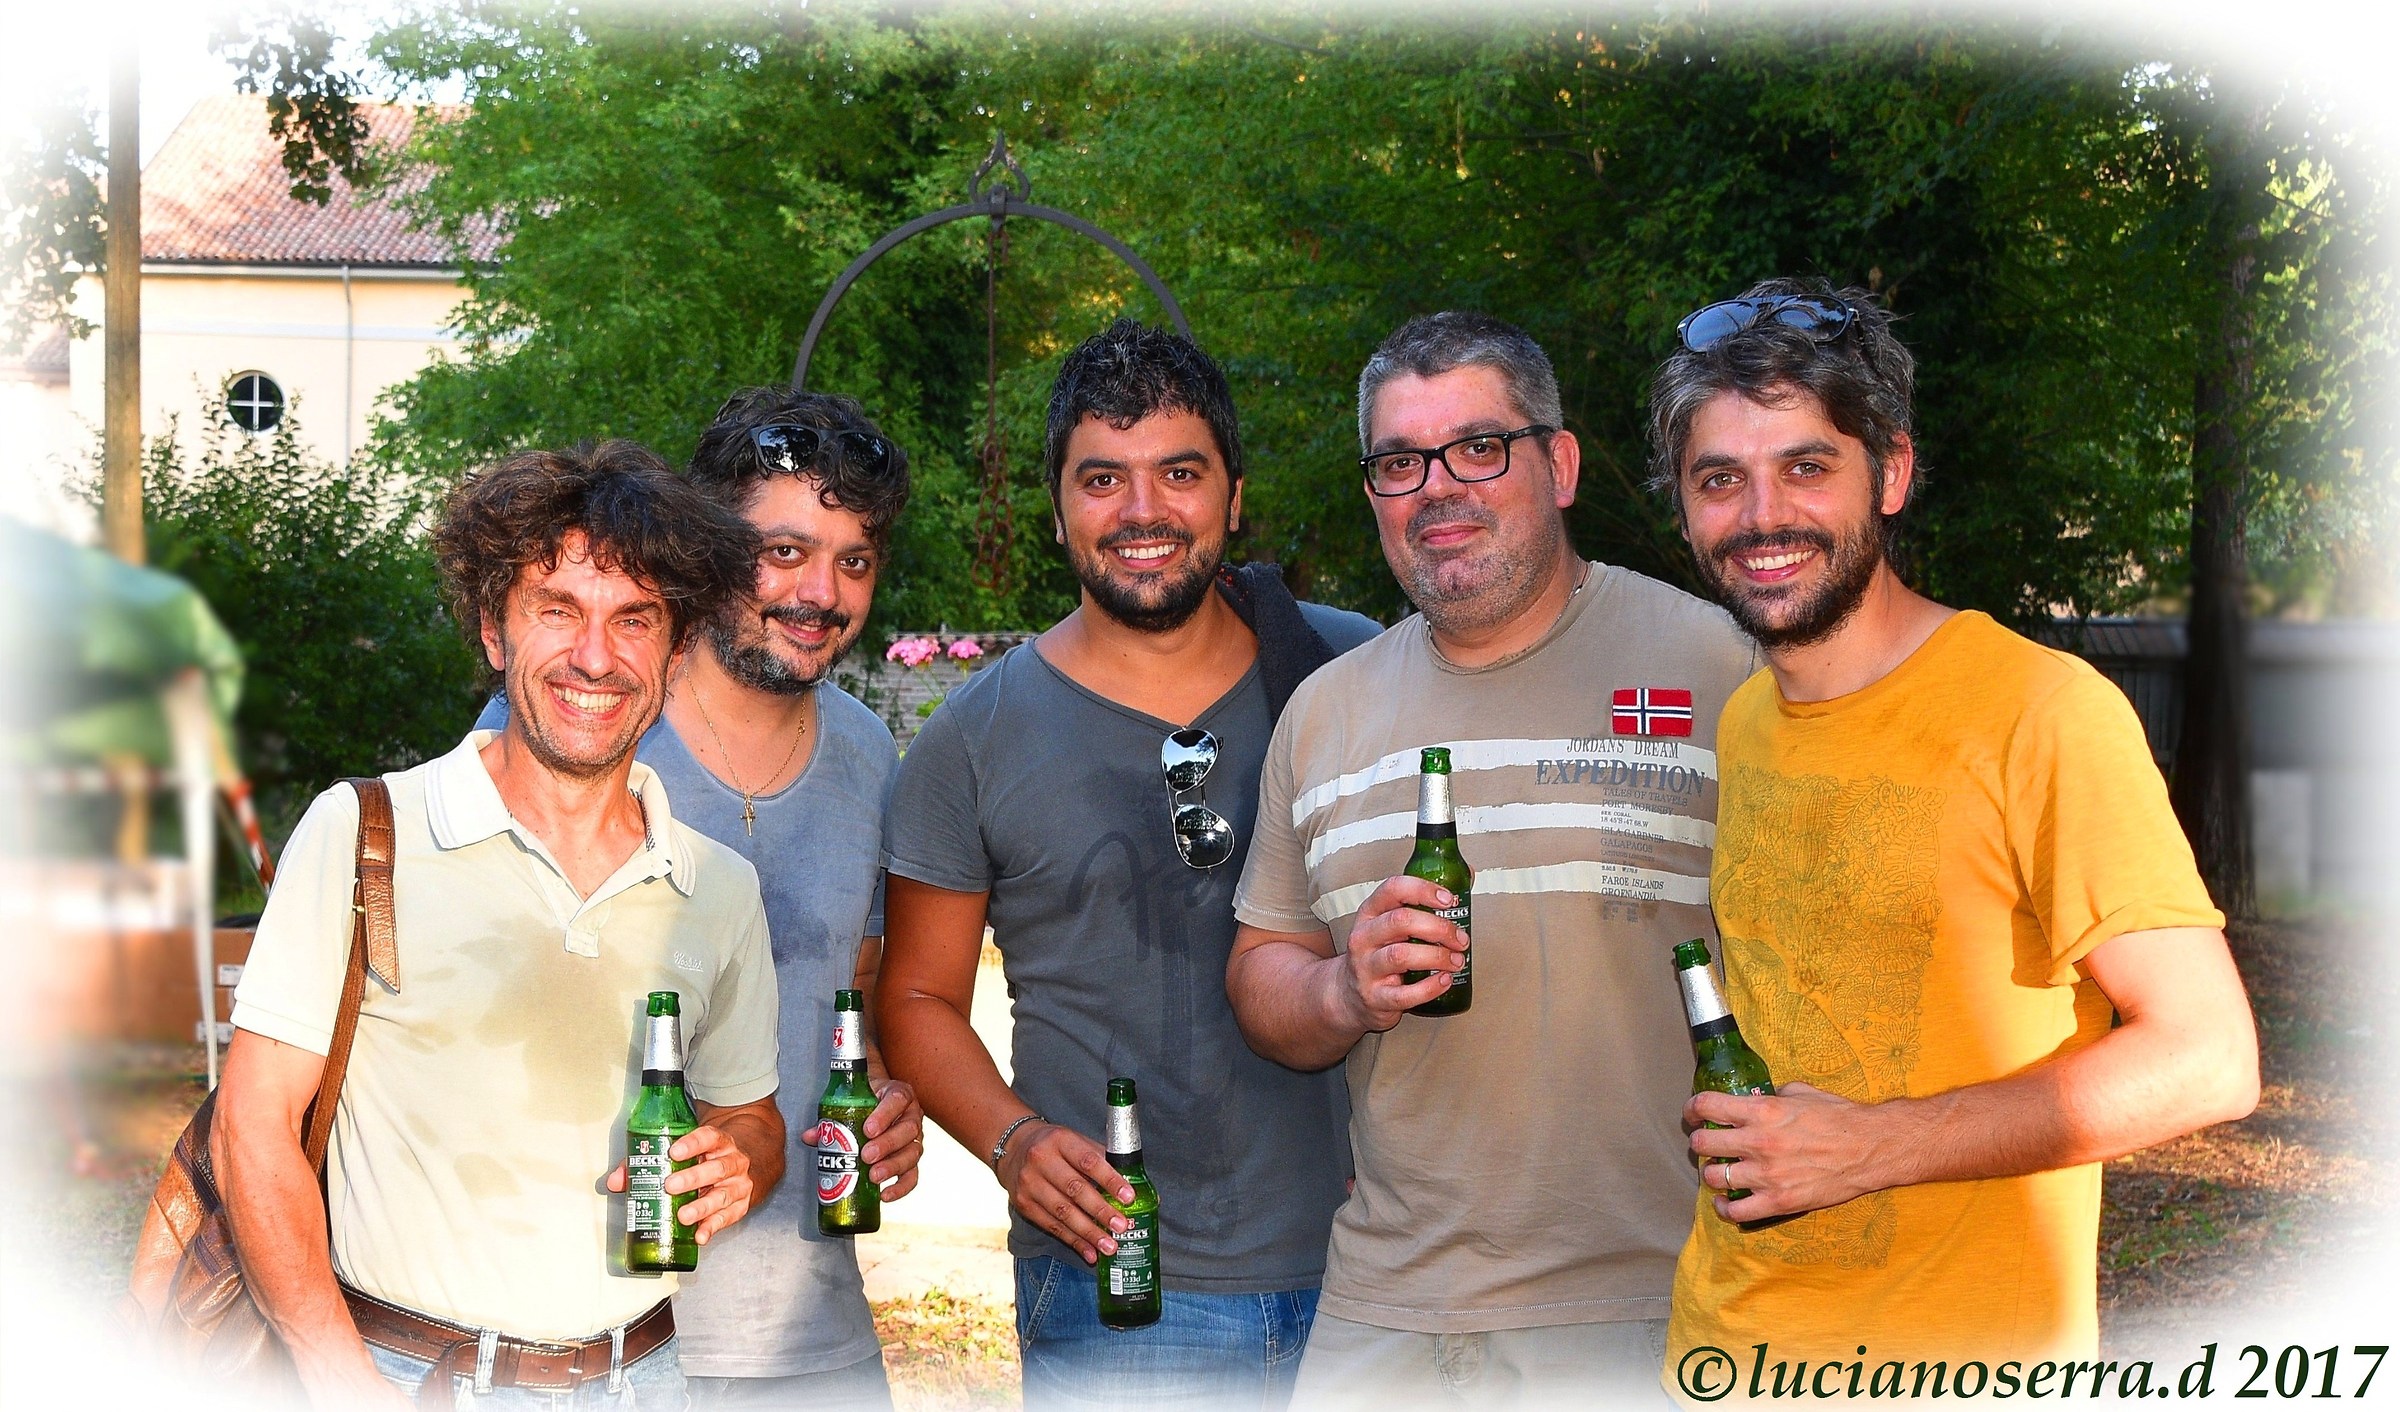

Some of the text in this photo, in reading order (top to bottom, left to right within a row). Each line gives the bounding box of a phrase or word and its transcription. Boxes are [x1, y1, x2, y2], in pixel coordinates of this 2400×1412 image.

[1634, 740, 1680, 759] DREAM
[1535, 758, 1705, 797] EXPEDITION
[1603, 787, 1688, 807] TALES OF TRAVELS
[1602, 799, 1674, 816] PORT MORESBY
[1601, 838, 1653, 854] GALAPAGOS
[1601, 875, 1665, 890] FAROE ISLANDS
[818, 1154, 857, 1169] ECK'S
